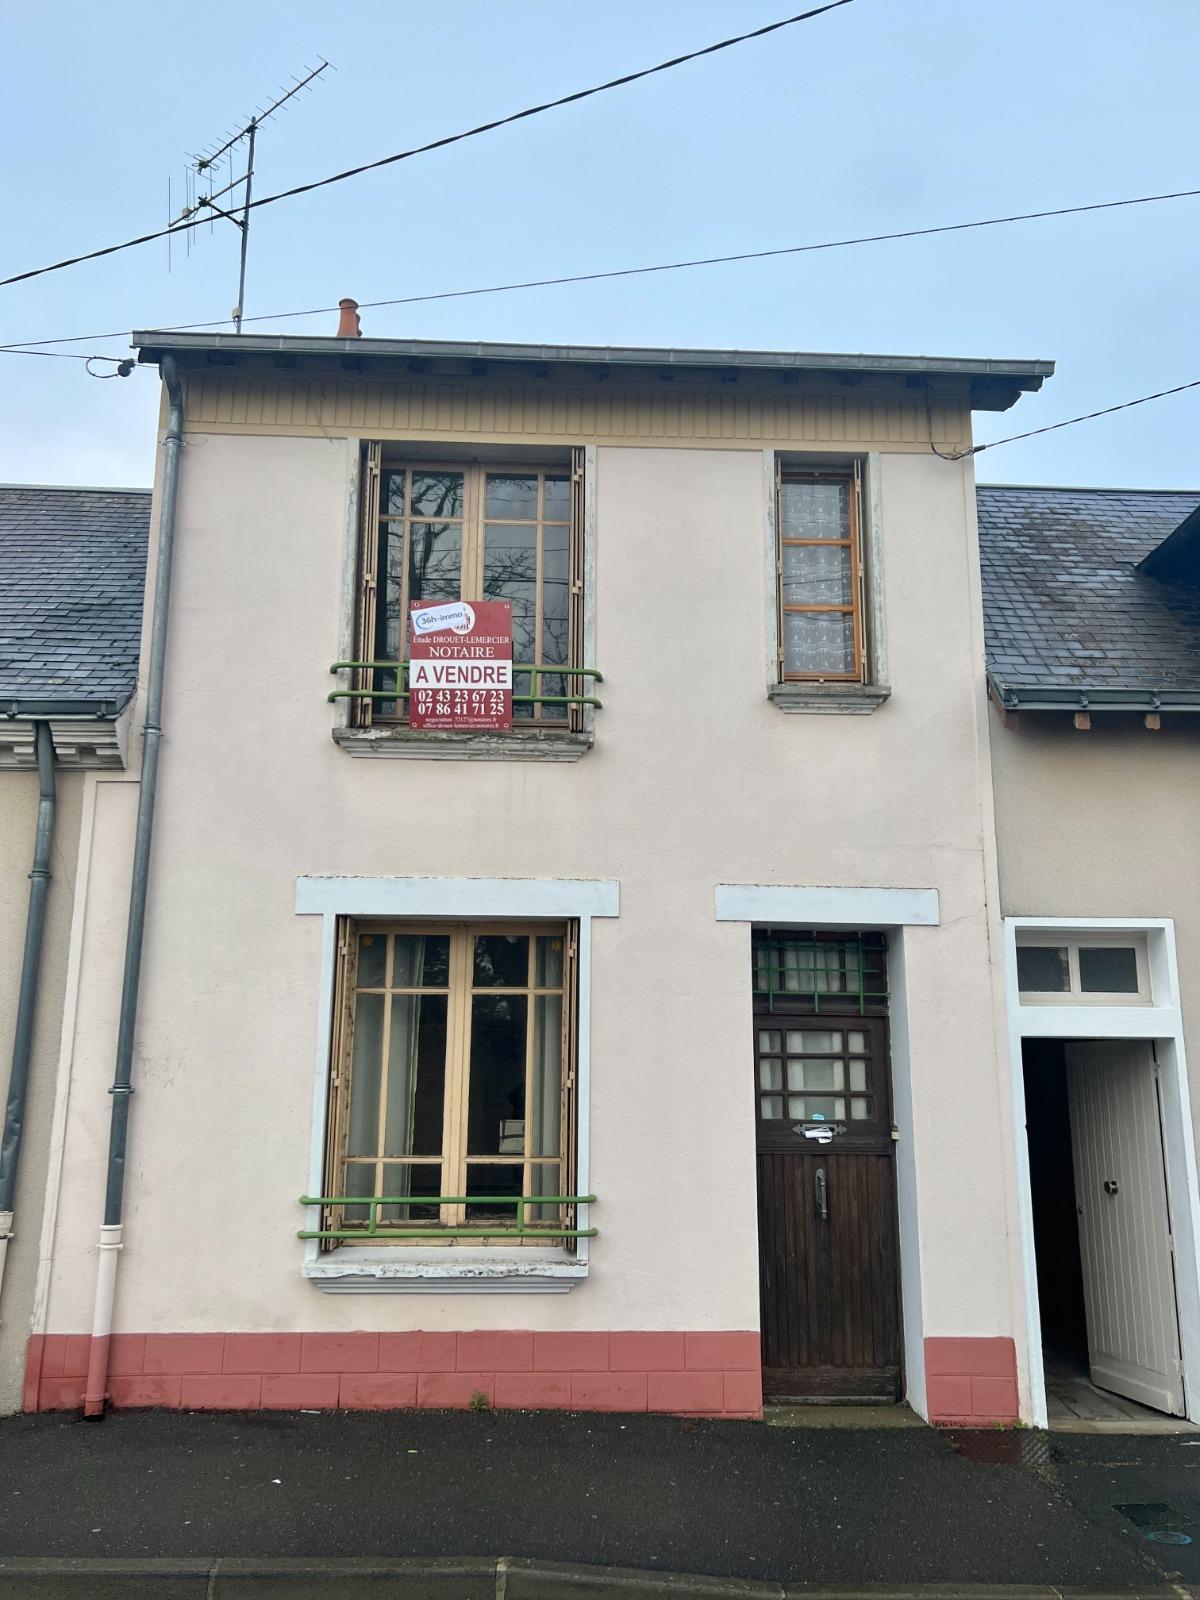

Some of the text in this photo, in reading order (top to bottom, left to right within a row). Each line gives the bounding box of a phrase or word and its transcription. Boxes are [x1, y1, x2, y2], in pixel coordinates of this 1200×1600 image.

[421, 612, 463, 626] 36h-immo
[433, 636, 510, 644] DROUET-LEMERCIER
[429, 646, 495, 658] NOTAIRE
[416, 666, 507, 684] A VENDRE
[418, 690, 504, 702] 02 43 23 67 23
[418, 703, 505, 715] 07 86 41 71 25
